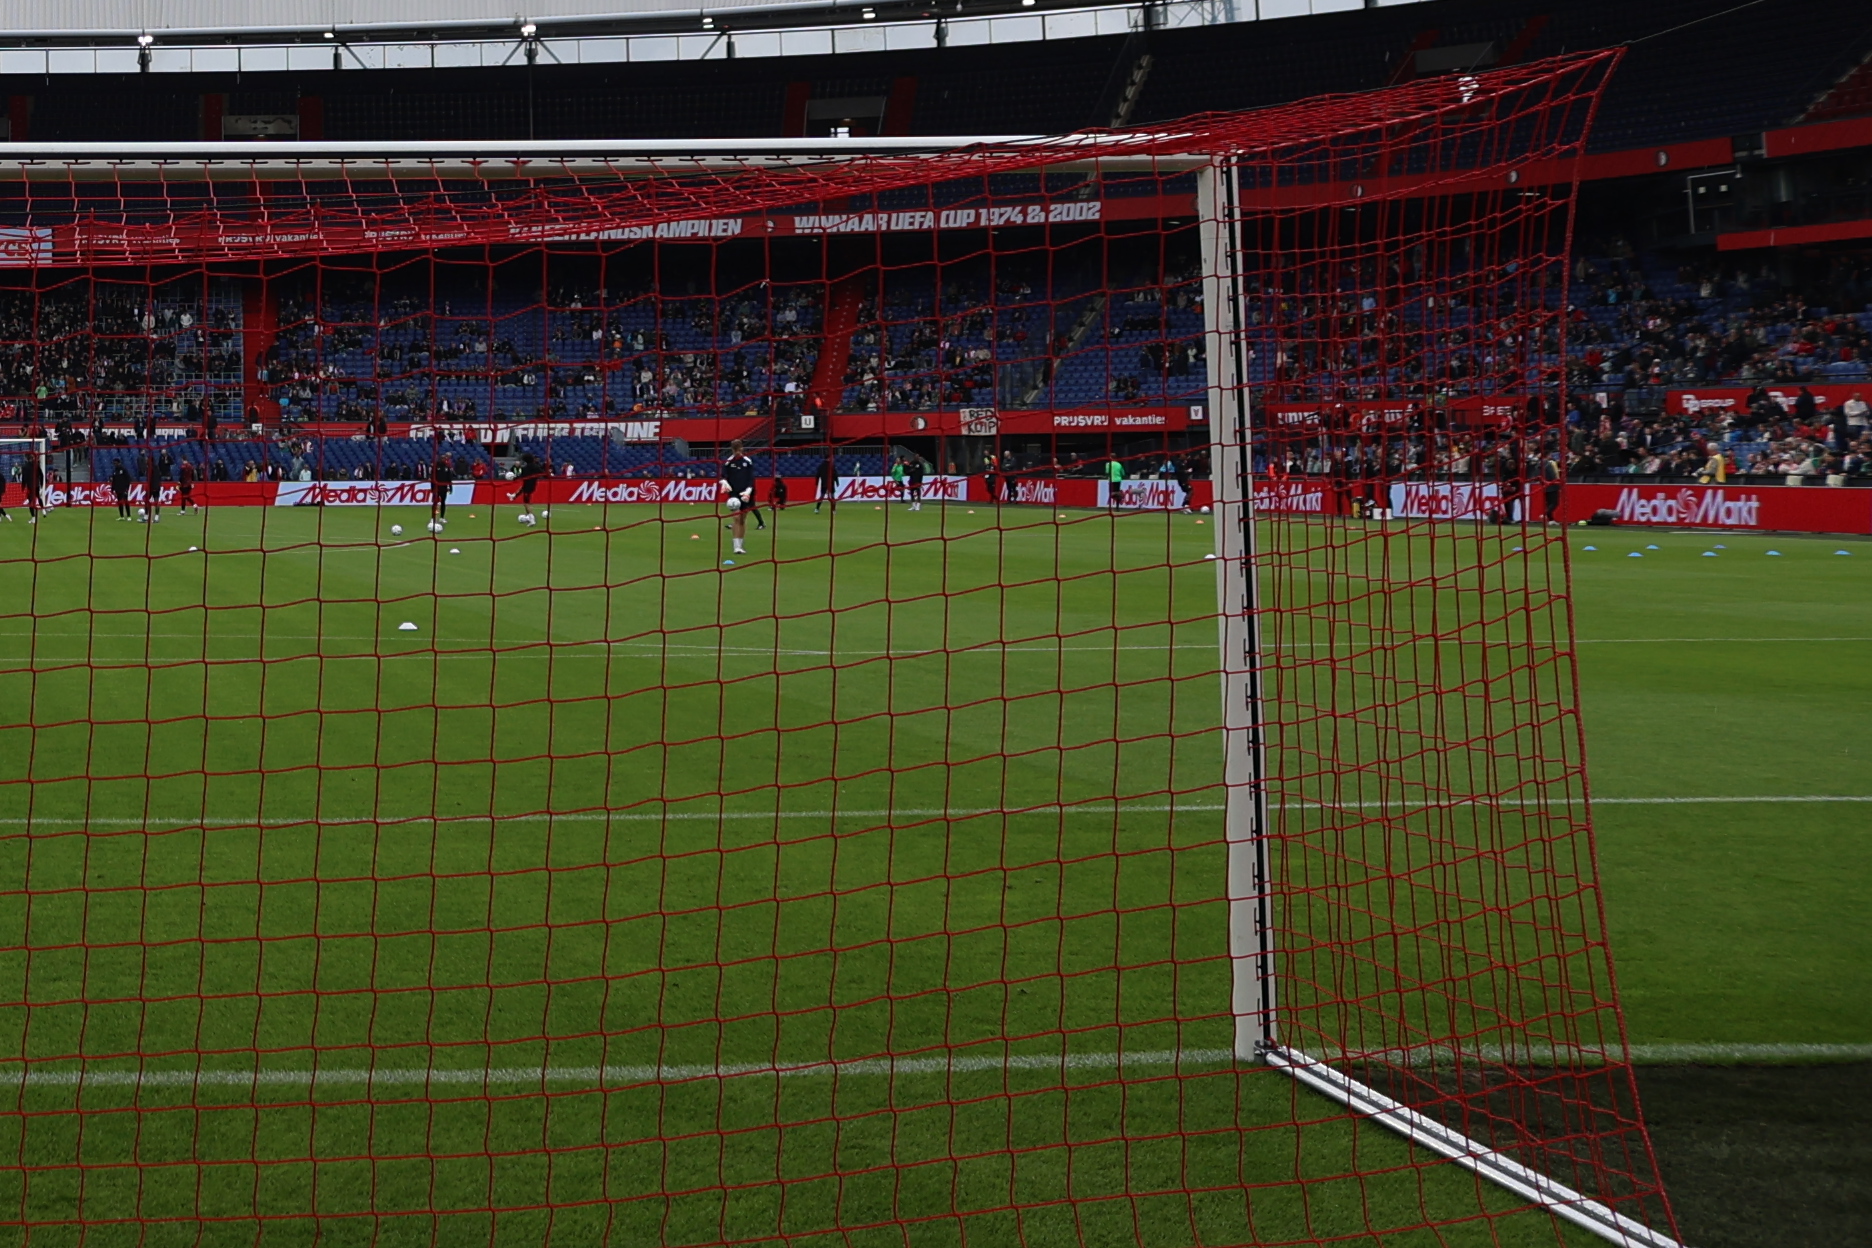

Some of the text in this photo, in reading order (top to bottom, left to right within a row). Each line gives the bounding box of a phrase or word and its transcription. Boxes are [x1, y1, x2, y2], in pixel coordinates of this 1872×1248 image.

[794, 213, 889, 234] WINNAAR
[889, 211, 936, 231] UEFA
[939, 208, 977, 229] CUP
[978, 205, 1025, 227] 1974
[1048, 201, 1102, 223] 2002
